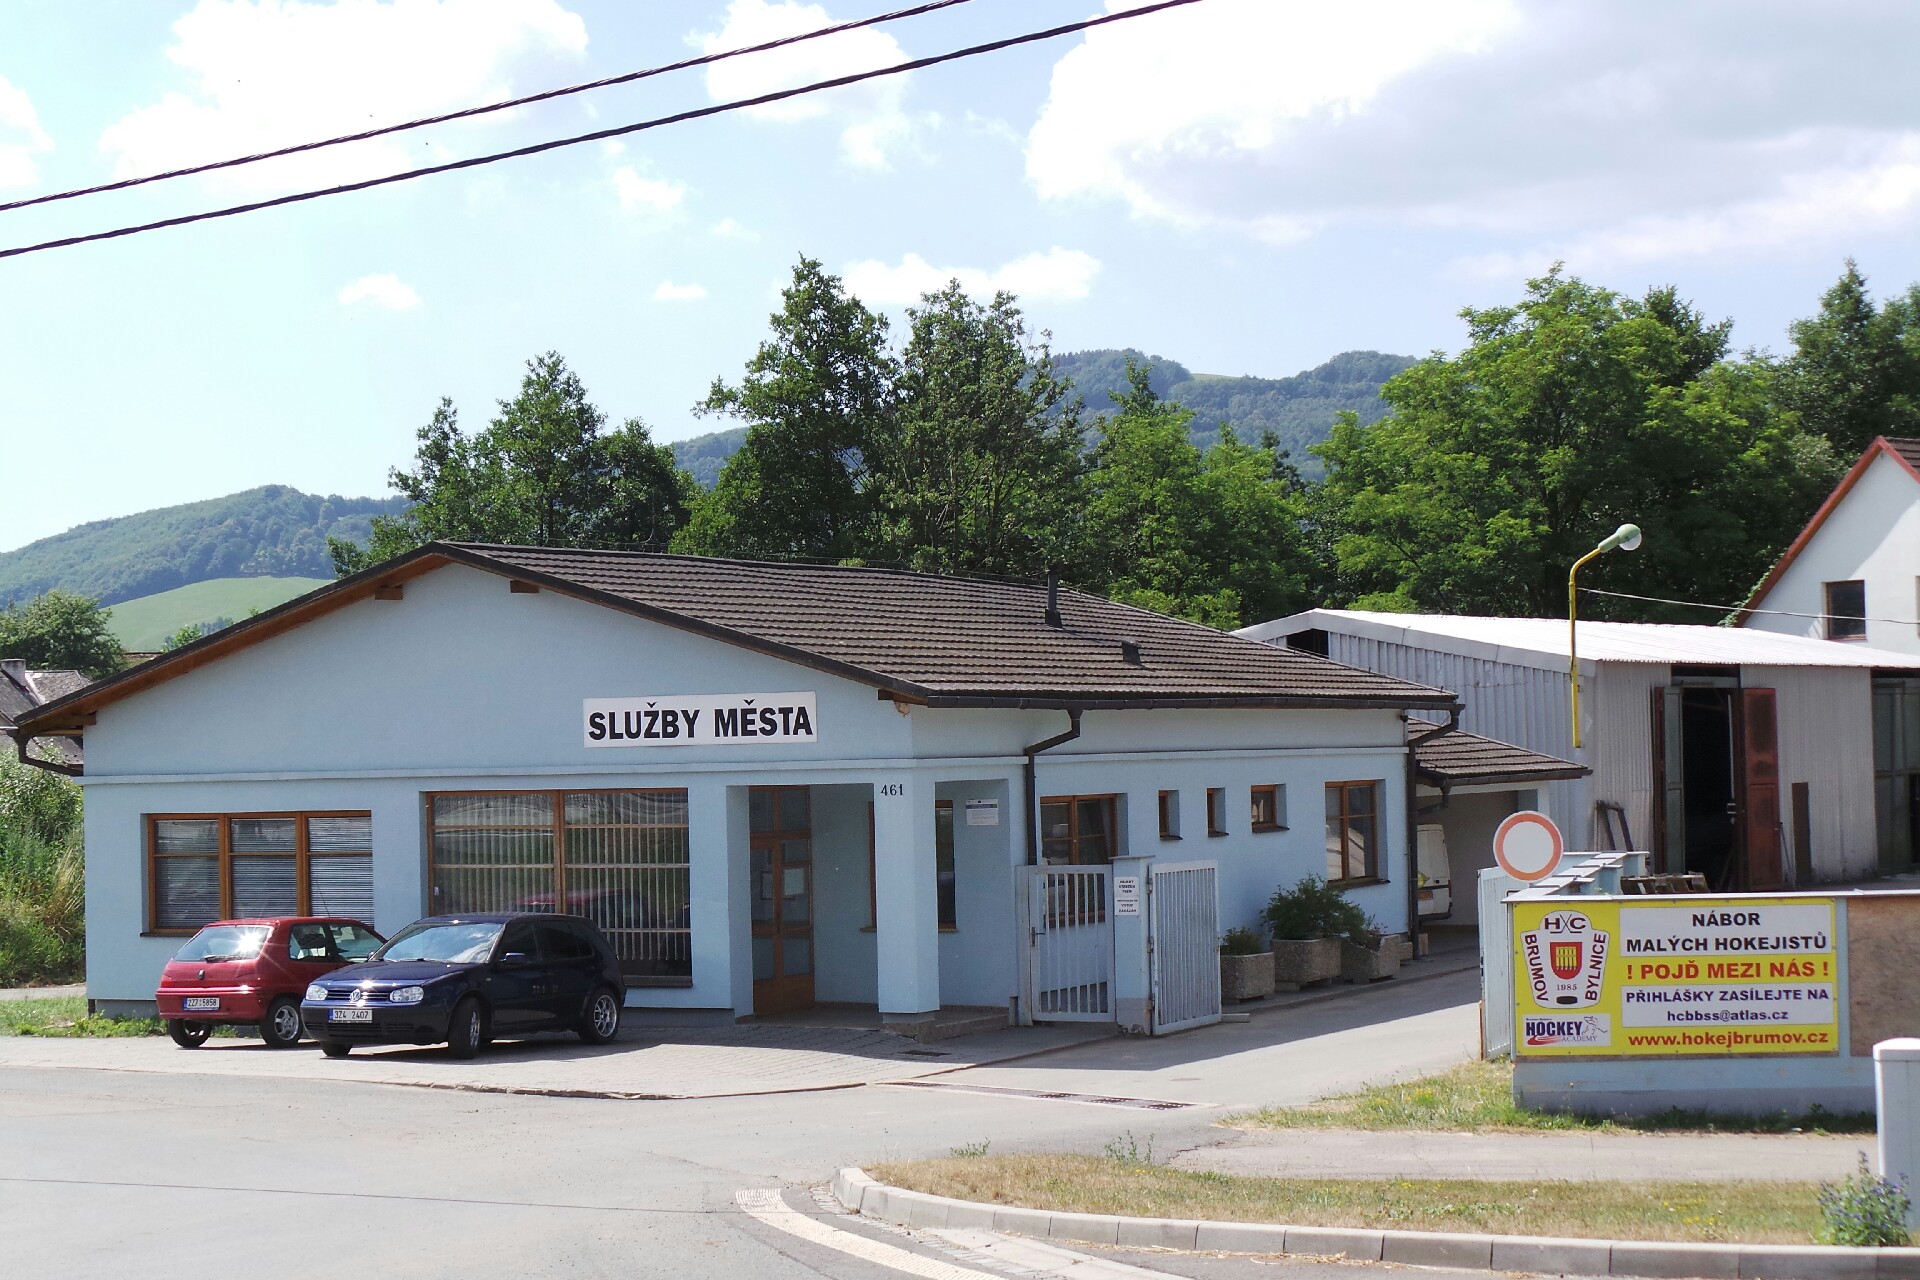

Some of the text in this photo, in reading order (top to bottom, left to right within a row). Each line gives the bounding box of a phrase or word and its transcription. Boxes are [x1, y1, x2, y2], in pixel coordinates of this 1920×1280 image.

[588, 698, 813, 741] SLUŽBY MĚSTA
[880, 783, 903, 796] 461
[1692, 909, 1761, 927] NÁBOR
[1626, 930, 1827, 953] MALÝCH HOKEJISTŮ
[1524, 933, 1550, 1002] BRUMOV
[1584, 933, 1607, 1001] BYLNICE
[1640, 959, 1700, 980] POJĎ
[1707, 962, 1762, 979] MEZI
[1769, 957, 1816, 978] NÁS
[1556, 983, 1578, 991] 1985
[1626, 987, 1830, 1004] PŘIHLÁŠKY ZASÍLEJTE NA
[351, 1010, 369, 1020] 2407
[1666, 1009, 1789, 1023] hcbbss@atlas.cz
[1525, 1021, 1583, 1037] HOCKEY
[1627, 1030, 1830, 1049] www.hokejbrumov.cz
